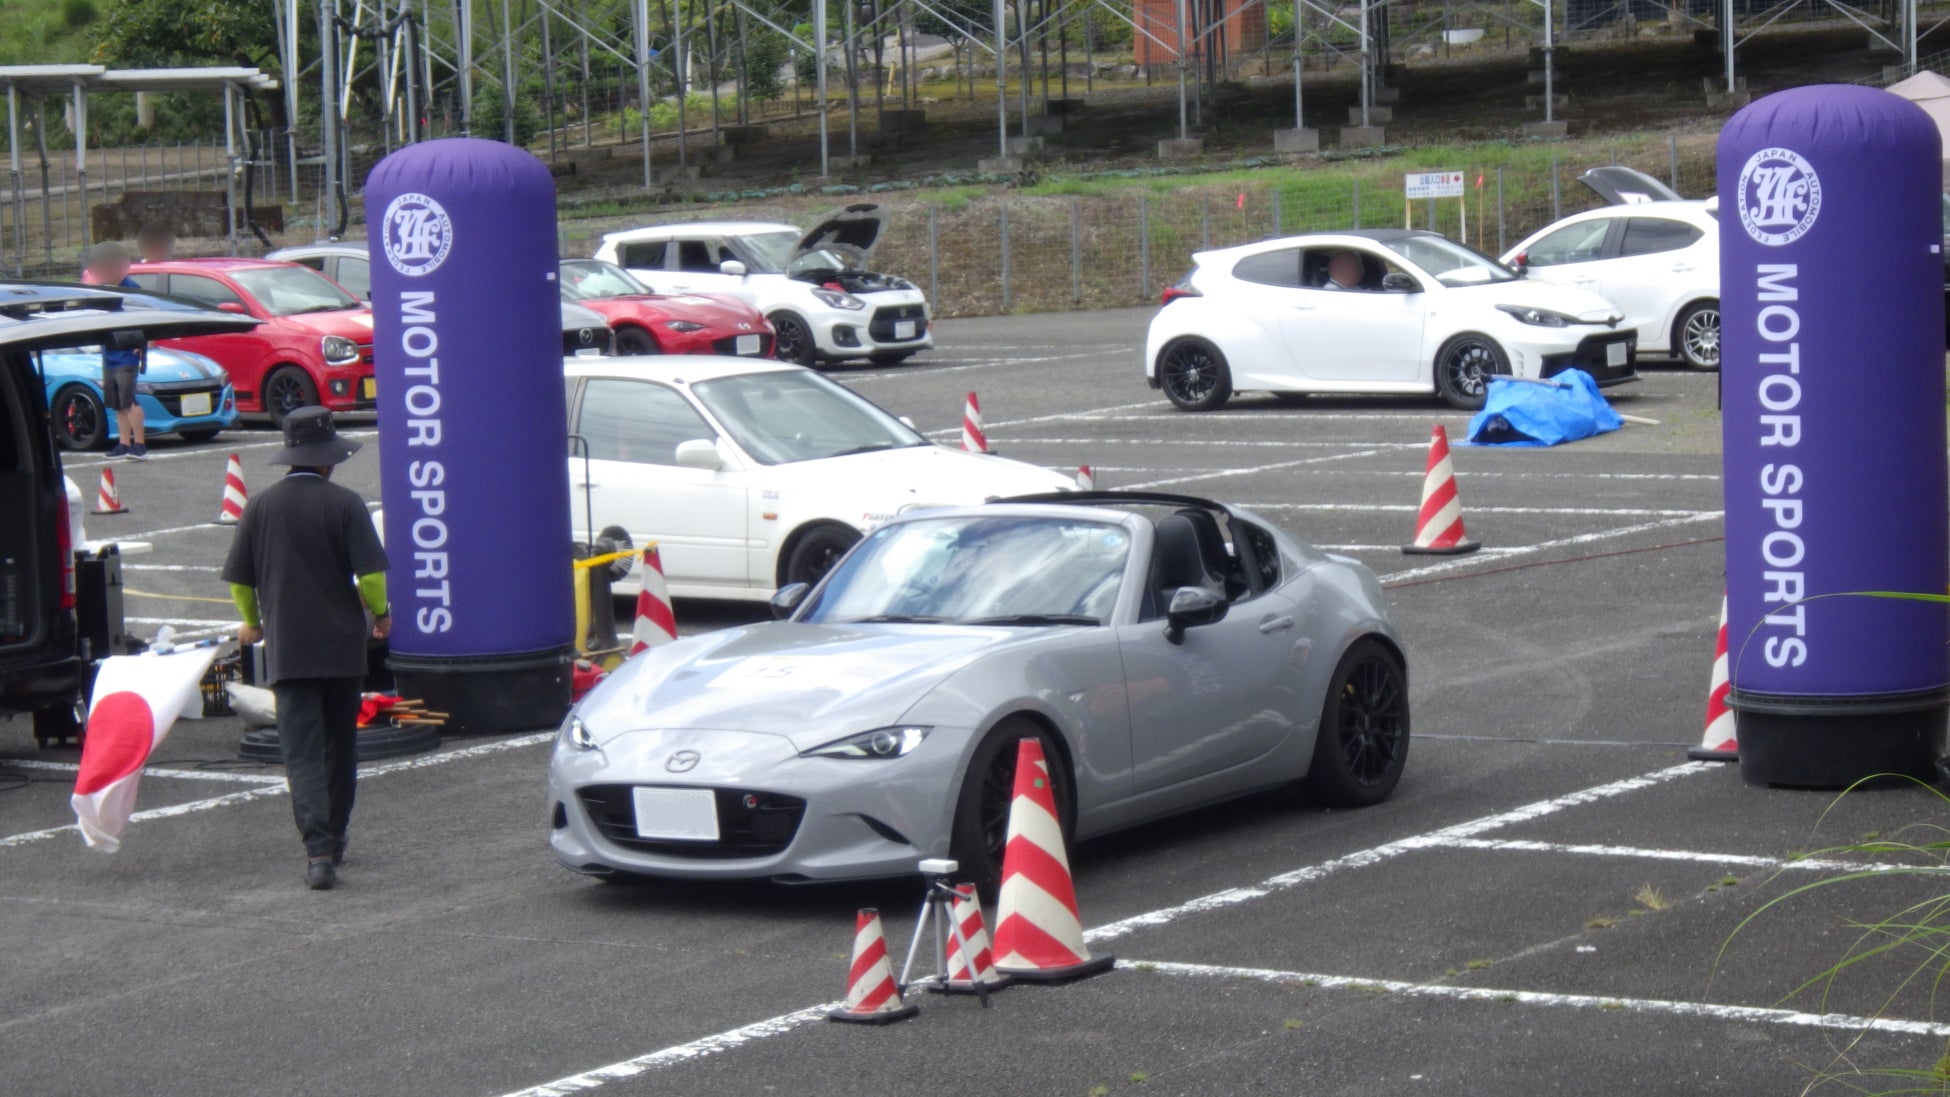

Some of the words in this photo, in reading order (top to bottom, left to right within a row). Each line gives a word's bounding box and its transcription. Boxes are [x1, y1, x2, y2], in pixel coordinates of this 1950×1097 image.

[1756, 150, 1797, 162] JAPAN
[1740, 174, 1770, 243] FEDERATION
[1749, 165, 1809, 227] JAF
[1782, 172, 1820, 242] AUTOMOBILE
[393, 208, 441, 260] JAF
[396, 194, 431, 206] JAPAN
[421, 213, 451, 273] AUTOMOBILE
[400, 291, 441, 447] MOTOR
[1757, 264, 1802, 447] MOTOR
[409, 460, 452, 634] SPORTS
[1760, 463, 1808, 668] SPORTS
